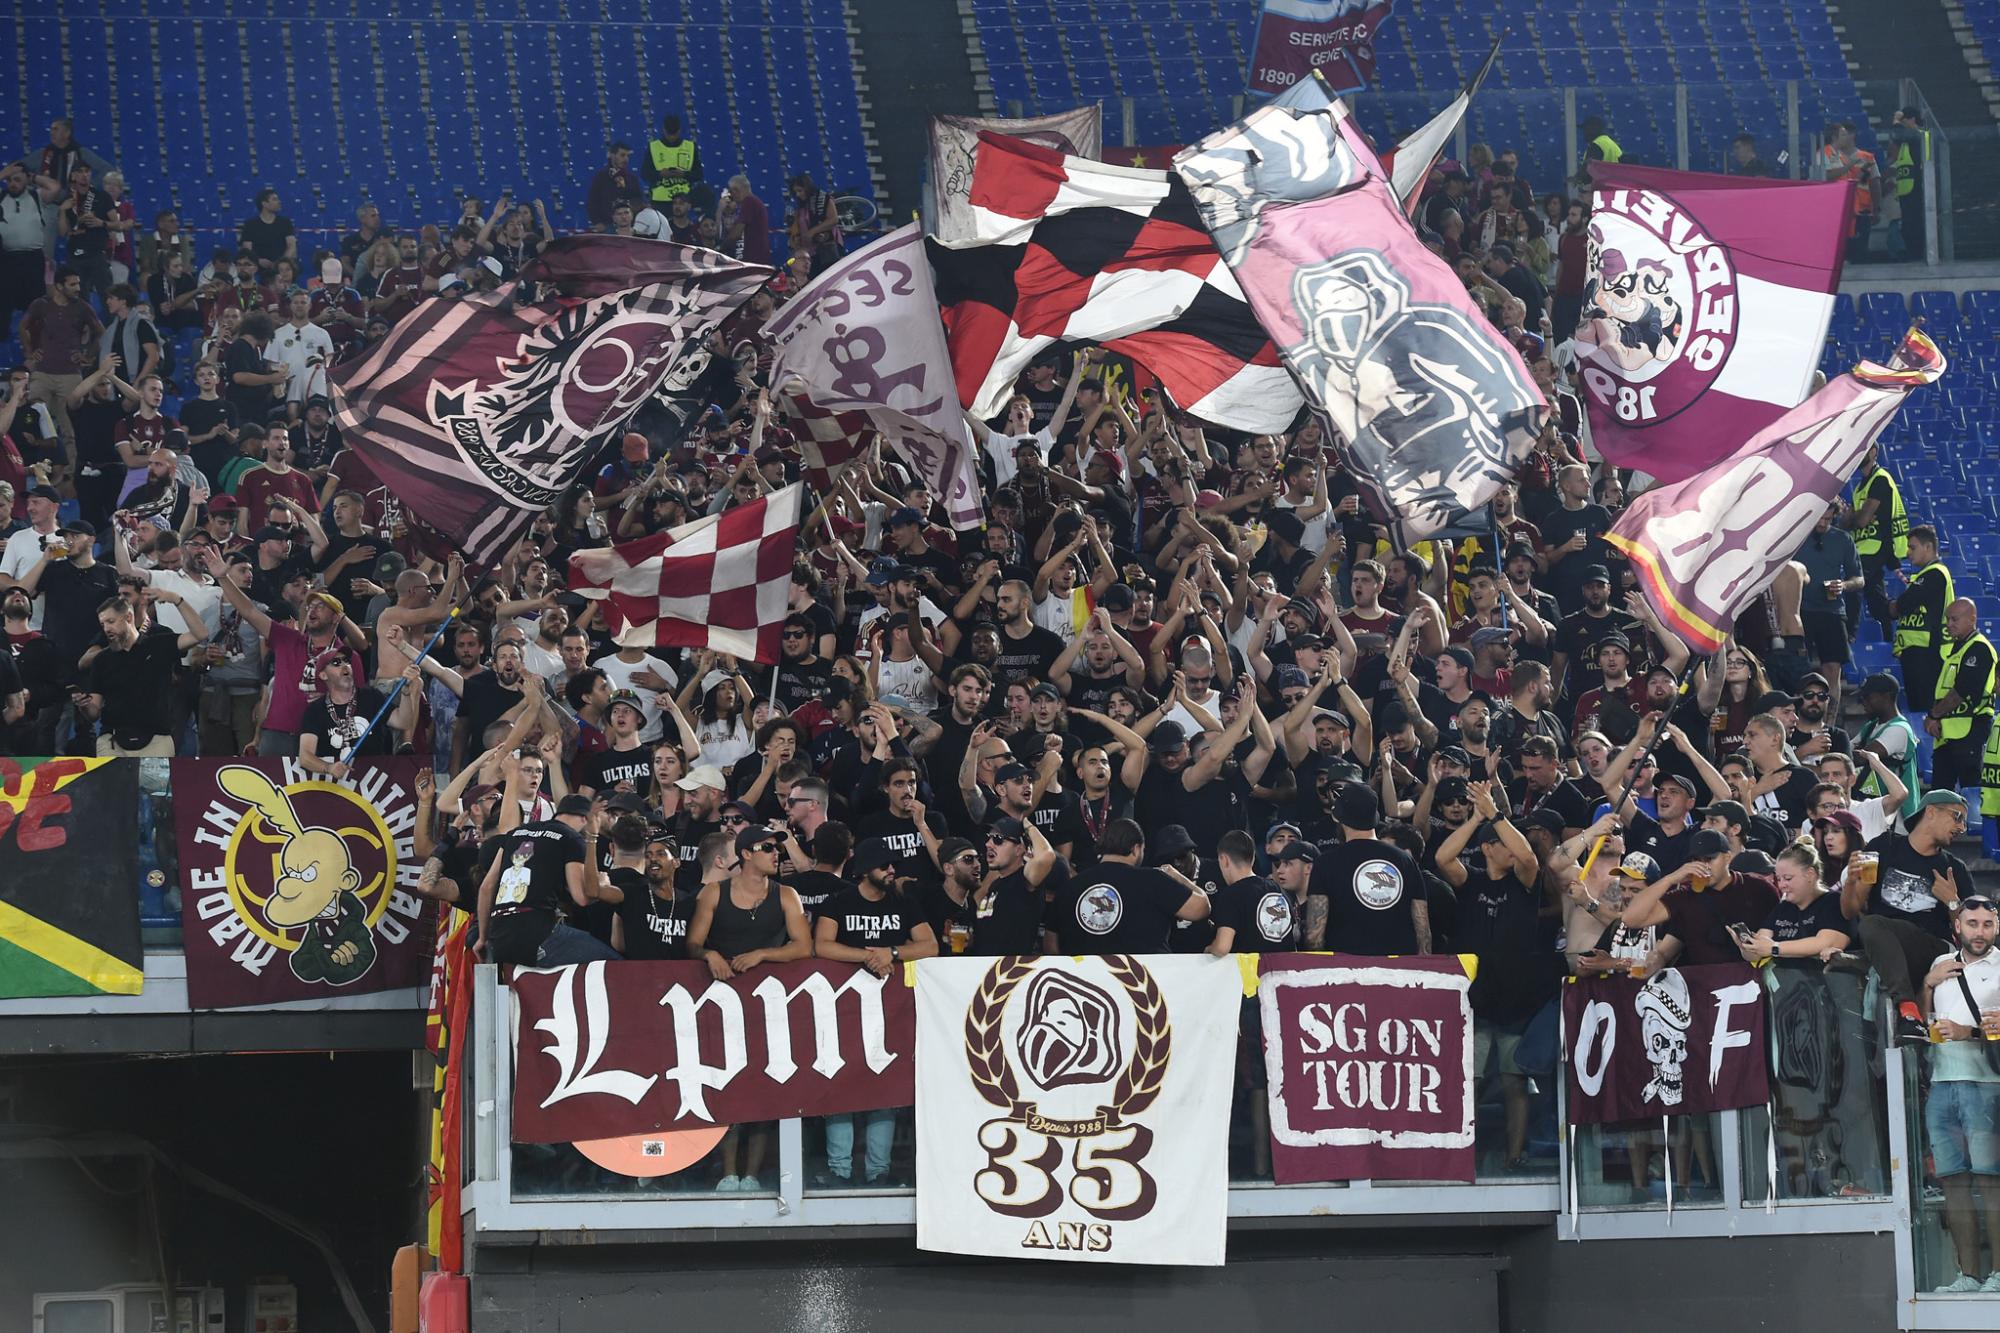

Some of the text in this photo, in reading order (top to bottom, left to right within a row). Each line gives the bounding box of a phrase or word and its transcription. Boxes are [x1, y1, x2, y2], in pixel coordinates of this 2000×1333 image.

[1258, 68, 1296, 86] 1890
[602, 762, 650, 785] ULTRAS
[193, 800, 243, 851] IN
[882, 832, 926, 850] ULTRA
[902, 848, 917, 858] LPM
[190, 866, 278, 976] MADE
[845, 914, 901, 931] ULTRAS
[864, 930, 880, 940] LPM
[512, 959, 899, 1124] Lpm
[1299, 1002, 1444, 1058] SG ON
[1573, 980, 1761, 1098] O F
[1302, 1060, 1443, 1115] TOUR
[1029, 1115, 1102, 1134] Depuis 1988
[973, 1116, 1158, 1222] 35
[1021, 1220, 1113, 1253] ANS
